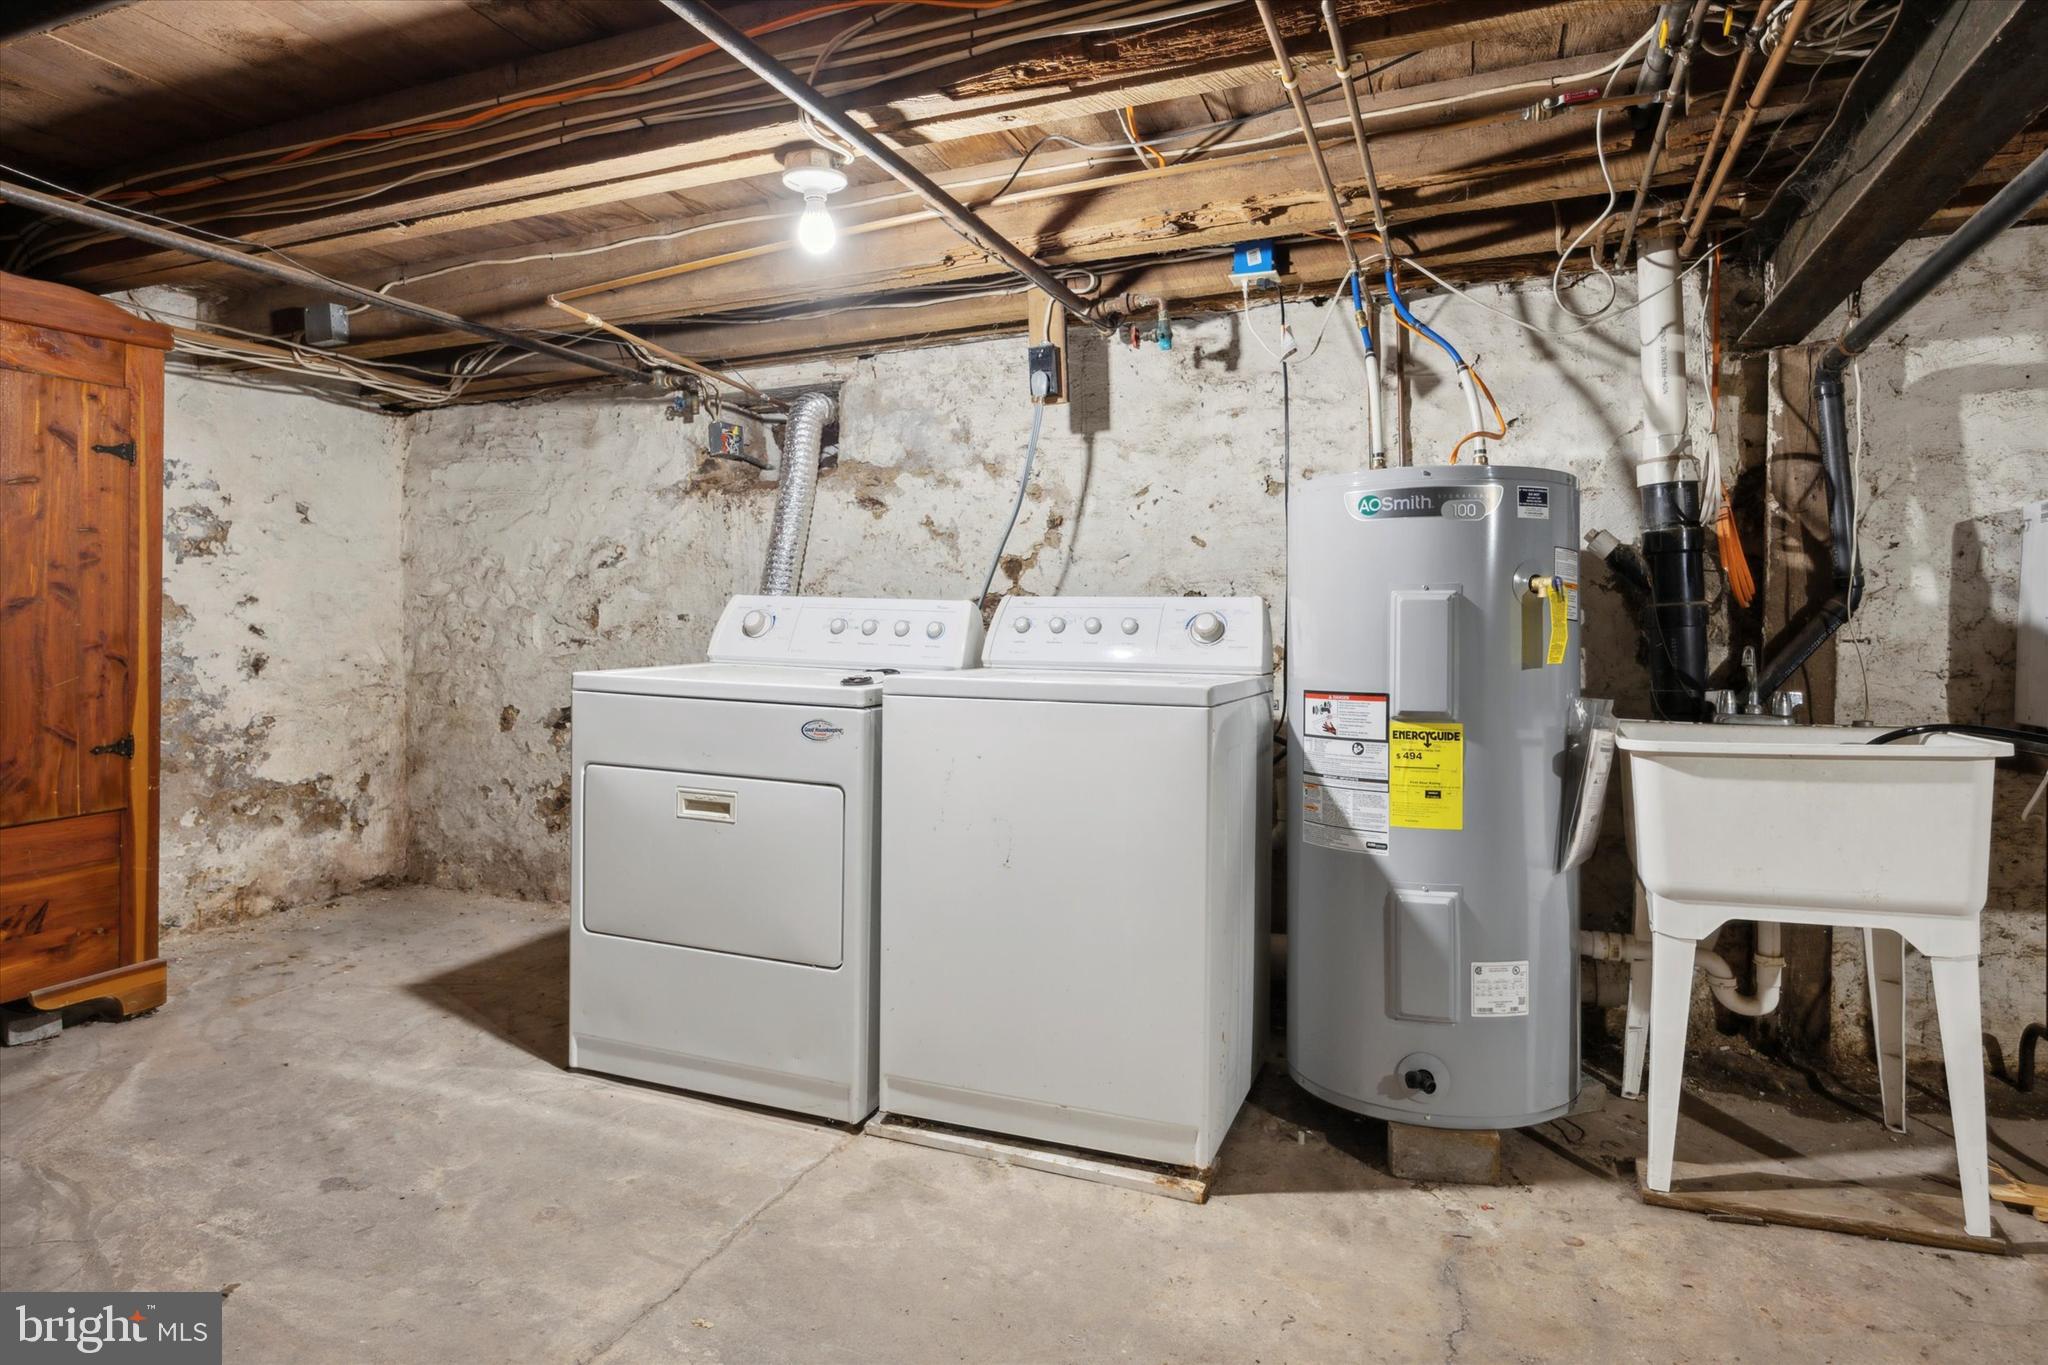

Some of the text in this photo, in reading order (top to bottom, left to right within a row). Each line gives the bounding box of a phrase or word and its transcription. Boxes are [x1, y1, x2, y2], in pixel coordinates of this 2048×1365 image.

[1452, 503, 1477, 517] 100
[1392, 730, 1461, 742] ENERGYGUIDE
[1403, 752, 1422, 760] 494
